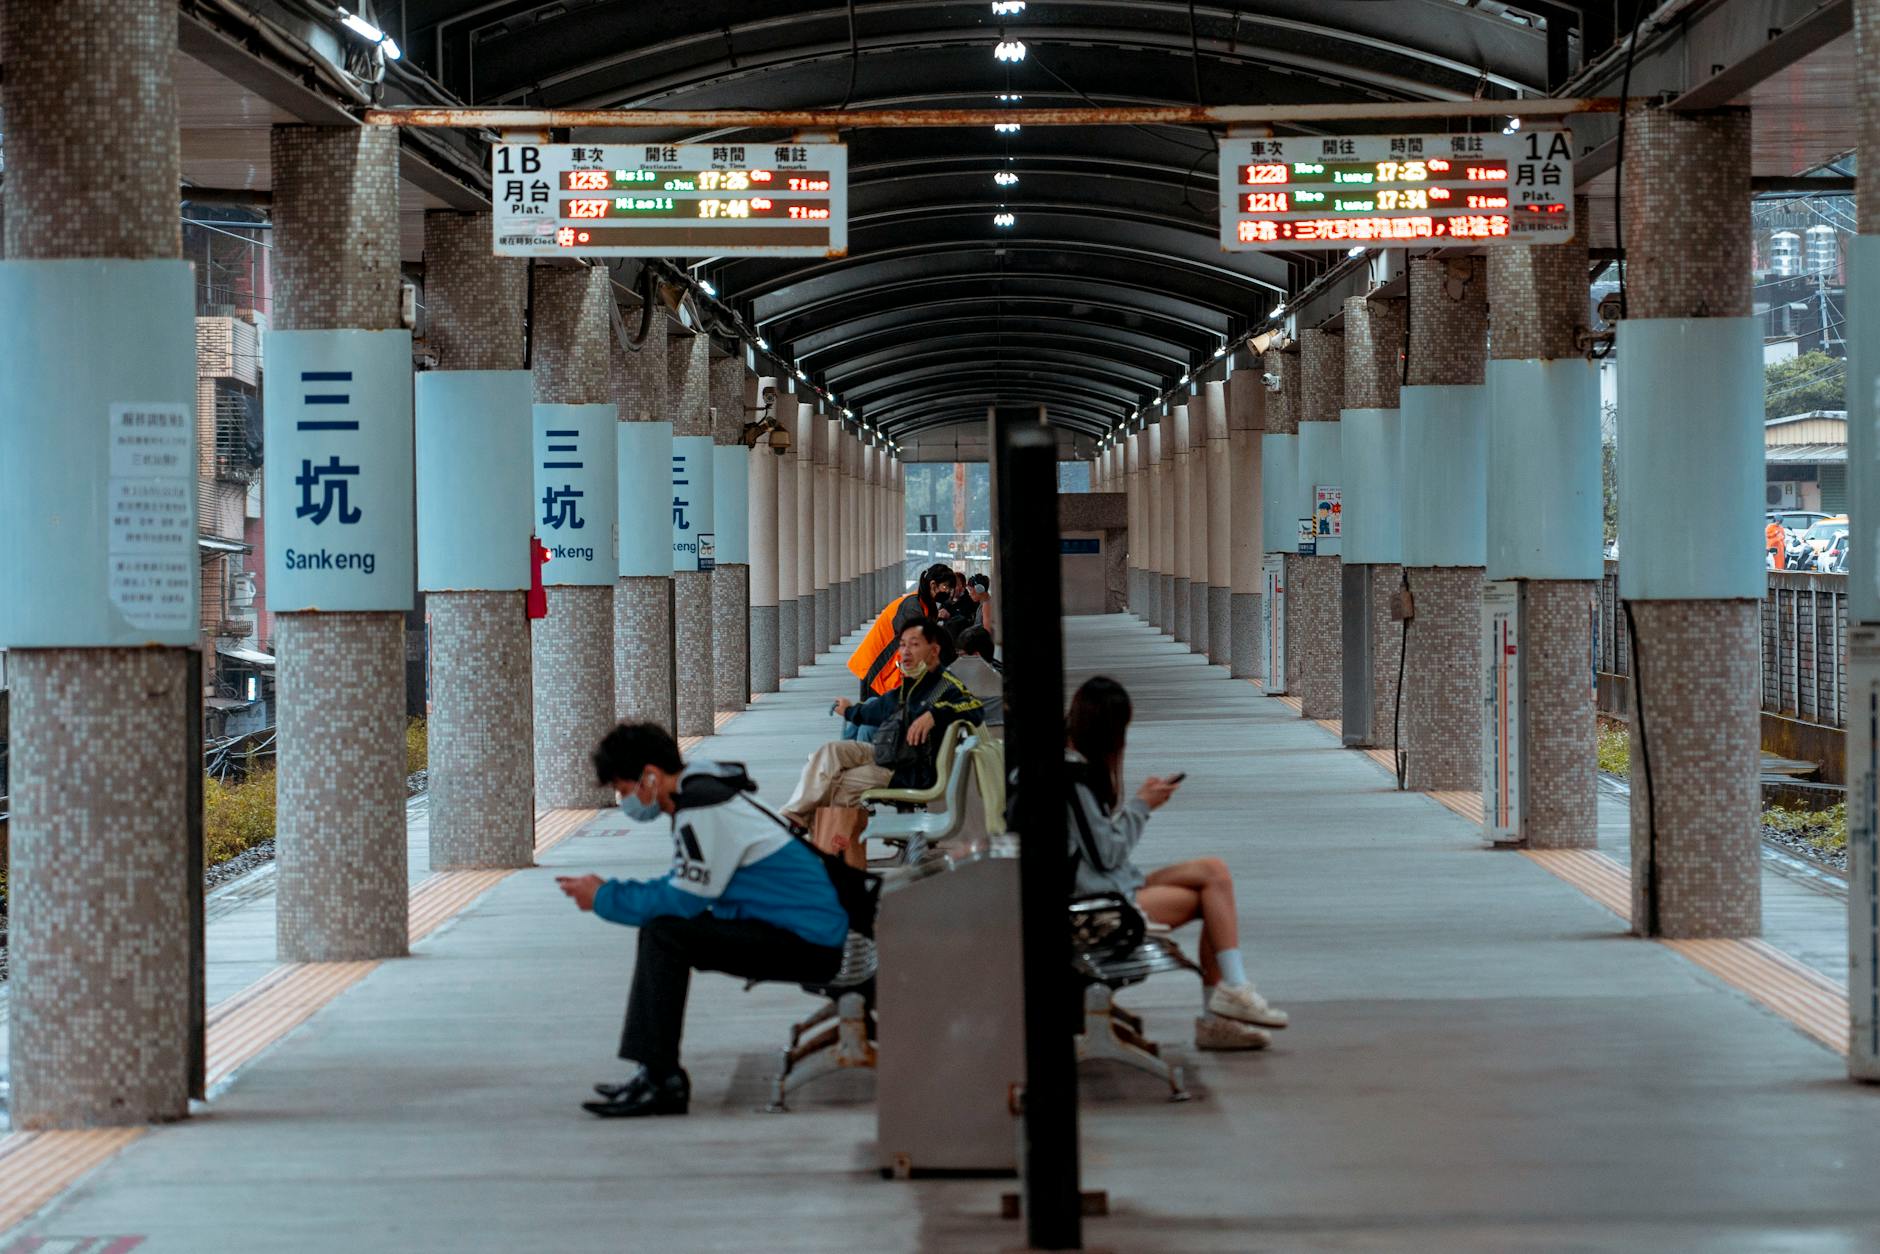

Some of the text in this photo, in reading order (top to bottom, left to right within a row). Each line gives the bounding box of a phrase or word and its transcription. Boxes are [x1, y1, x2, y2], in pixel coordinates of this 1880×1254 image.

[1251, 141, 1283, 156] 車次
[1323, 140, 1355, 155] 開往
[1391, 138, 1423, 153] 時間
[1451, 137, 1483, 152] 備註
[1526, 133, 1571, 160] 1A
[498, 146, 541, 174] 1B
[571, 147, 604, 162] 車次
[645, 147, 678, 162] 開往
[712, 147, 745, 162] 時間
[774, 147, 807, 162] 備註
[1515, 162, 1562, 186] 月台
[504, 179, 551, 203] 月台
[1522, 191, 1555, 201] Plat.
[511, 204, 545, 214] Plat.
[568, 199, 609, 218] 1237
[296, 371, 362, 526] 三坑
[542, 430, 585, 530] 三坑
[551, 544, 594, 561] nkeng
[286, 548, 375, 574] Sankeng
